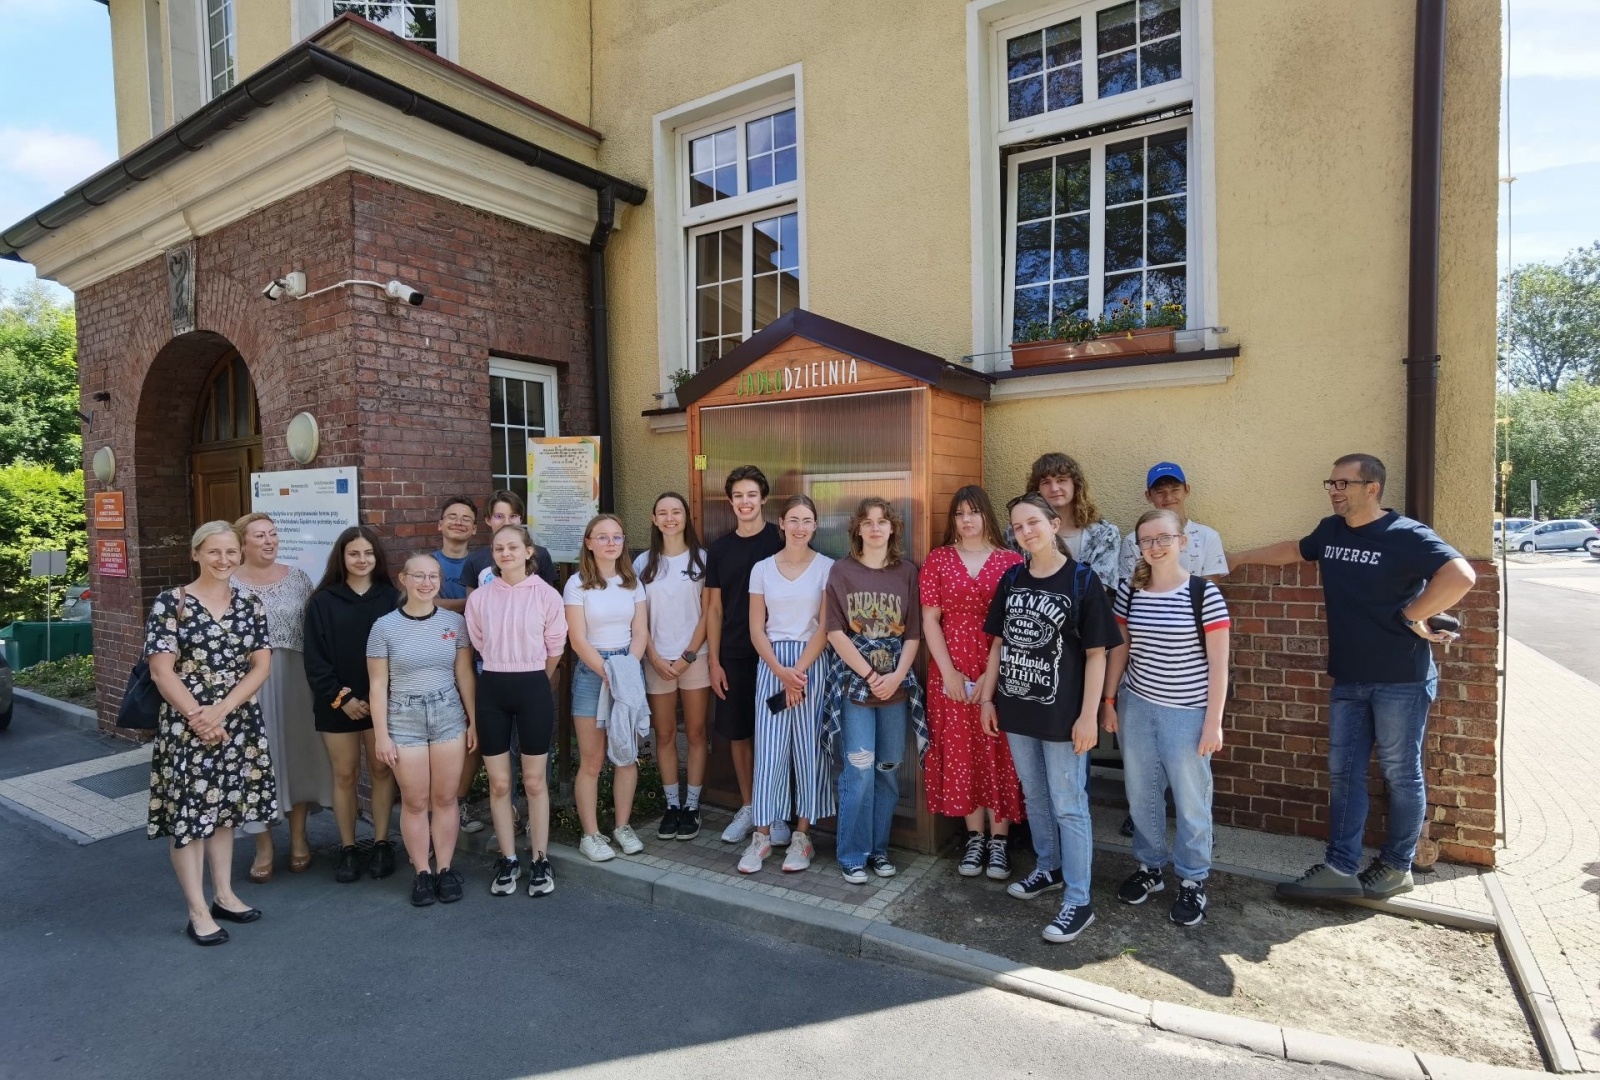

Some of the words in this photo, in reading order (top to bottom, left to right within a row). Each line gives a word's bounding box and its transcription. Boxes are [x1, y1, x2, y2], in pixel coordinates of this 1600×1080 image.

[737, 358, 858, 397] JADŁODZIELNIA
[1324, 545, 1382, 565] DIVERSE
[846, 591, 902, 626] ENDLESS
[1016, 619, 1034, 629] Old
[1013, 634, 1033, 643] BAND
